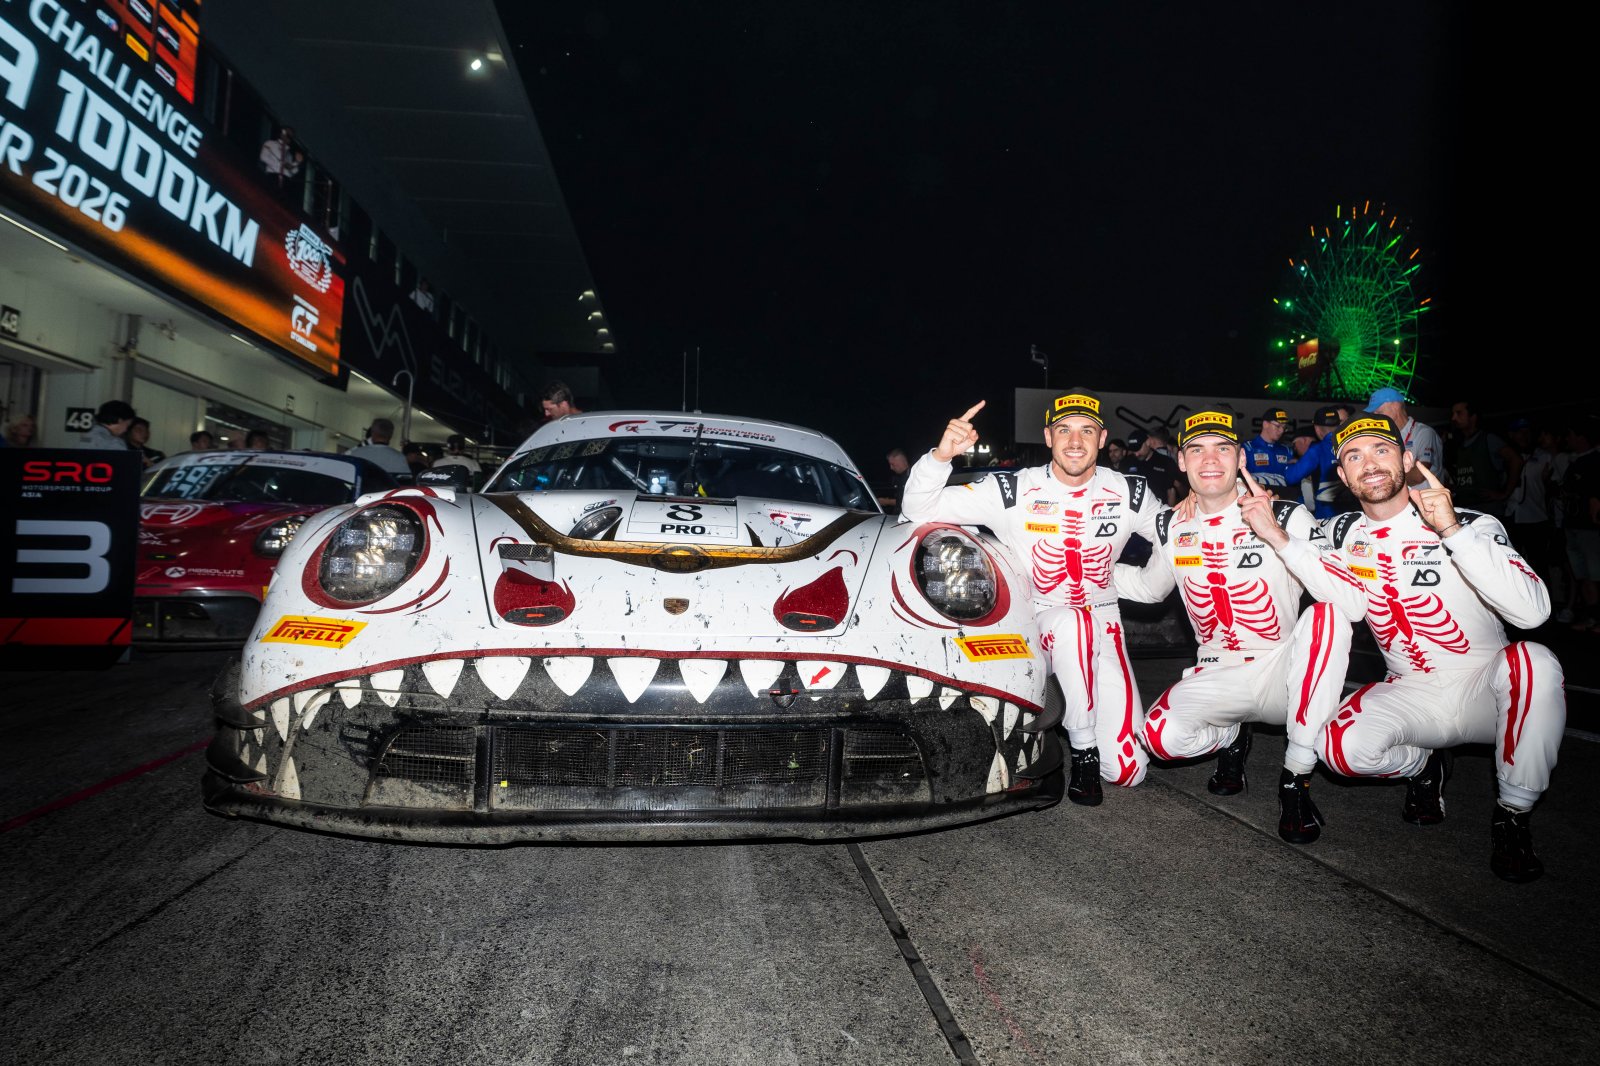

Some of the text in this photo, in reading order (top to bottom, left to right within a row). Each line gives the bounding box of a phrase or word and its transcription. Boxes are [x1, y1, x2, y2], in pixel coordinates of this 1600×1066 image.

[29, 0, 203, 158] CHALLENGE
[0, 115, 130, 232] R 2026
[56, 69, 260, 268] 1000KM
[1058, 399, 1097, 409] PIRELLI
[66, 411, 93, 430] 48
[1188, 414, 1231, 427] PIRELLI
[1340, 421, 1385, 439] PIRELLI
[22, 460, 114, 484] SRO
[666, 504, 703, 521] 8
[660, 523, 706, 535] PRO
[1028, 522, 1057, 533] PIRELLI
[11, 519, 112, 594] 3
[1175, 557, 1200, 566] PIRELLI
[272, 619, 355, 643] PIRELLI
[964, 638, 1028, 657] PIRELLI
